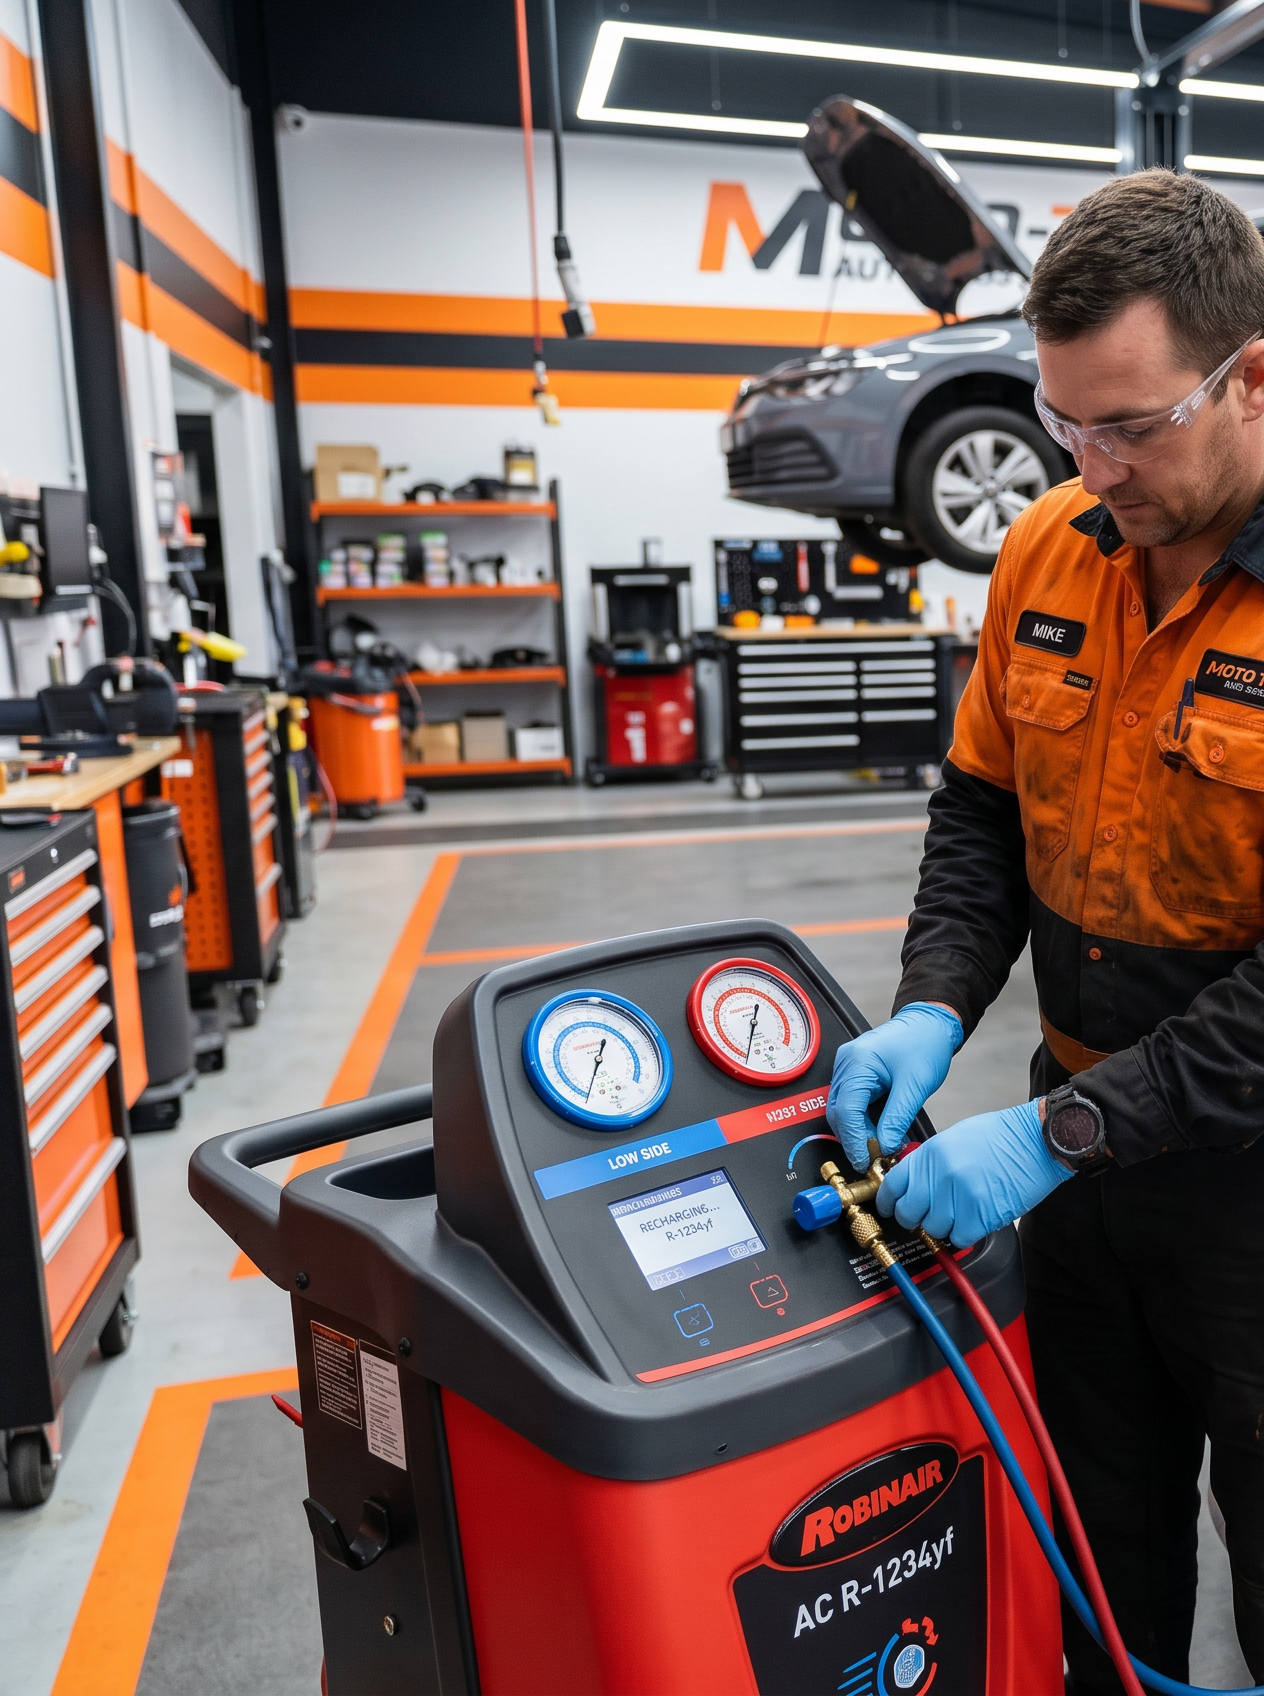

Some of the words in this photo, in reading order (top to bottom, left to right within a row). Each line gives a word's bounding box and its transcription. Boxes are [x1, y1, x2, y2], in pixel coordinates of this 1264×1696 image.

[1032, 622, 1066, 643] MIKE
[1205, 660, 1257, 683] MOTO
[799, 1095, 827, 1113] SIDE
[607, 1149, 639, 1170] LOW
[642, 1142, 672, 1161] SIDE
[665, 1218, 714, 1242] R-1234yf
[800, 1459, 944, 1558] ROBINAIR
[793, 1593, 834, 1638] AC
[841, 1526, 954, 1612] R-1234yf
